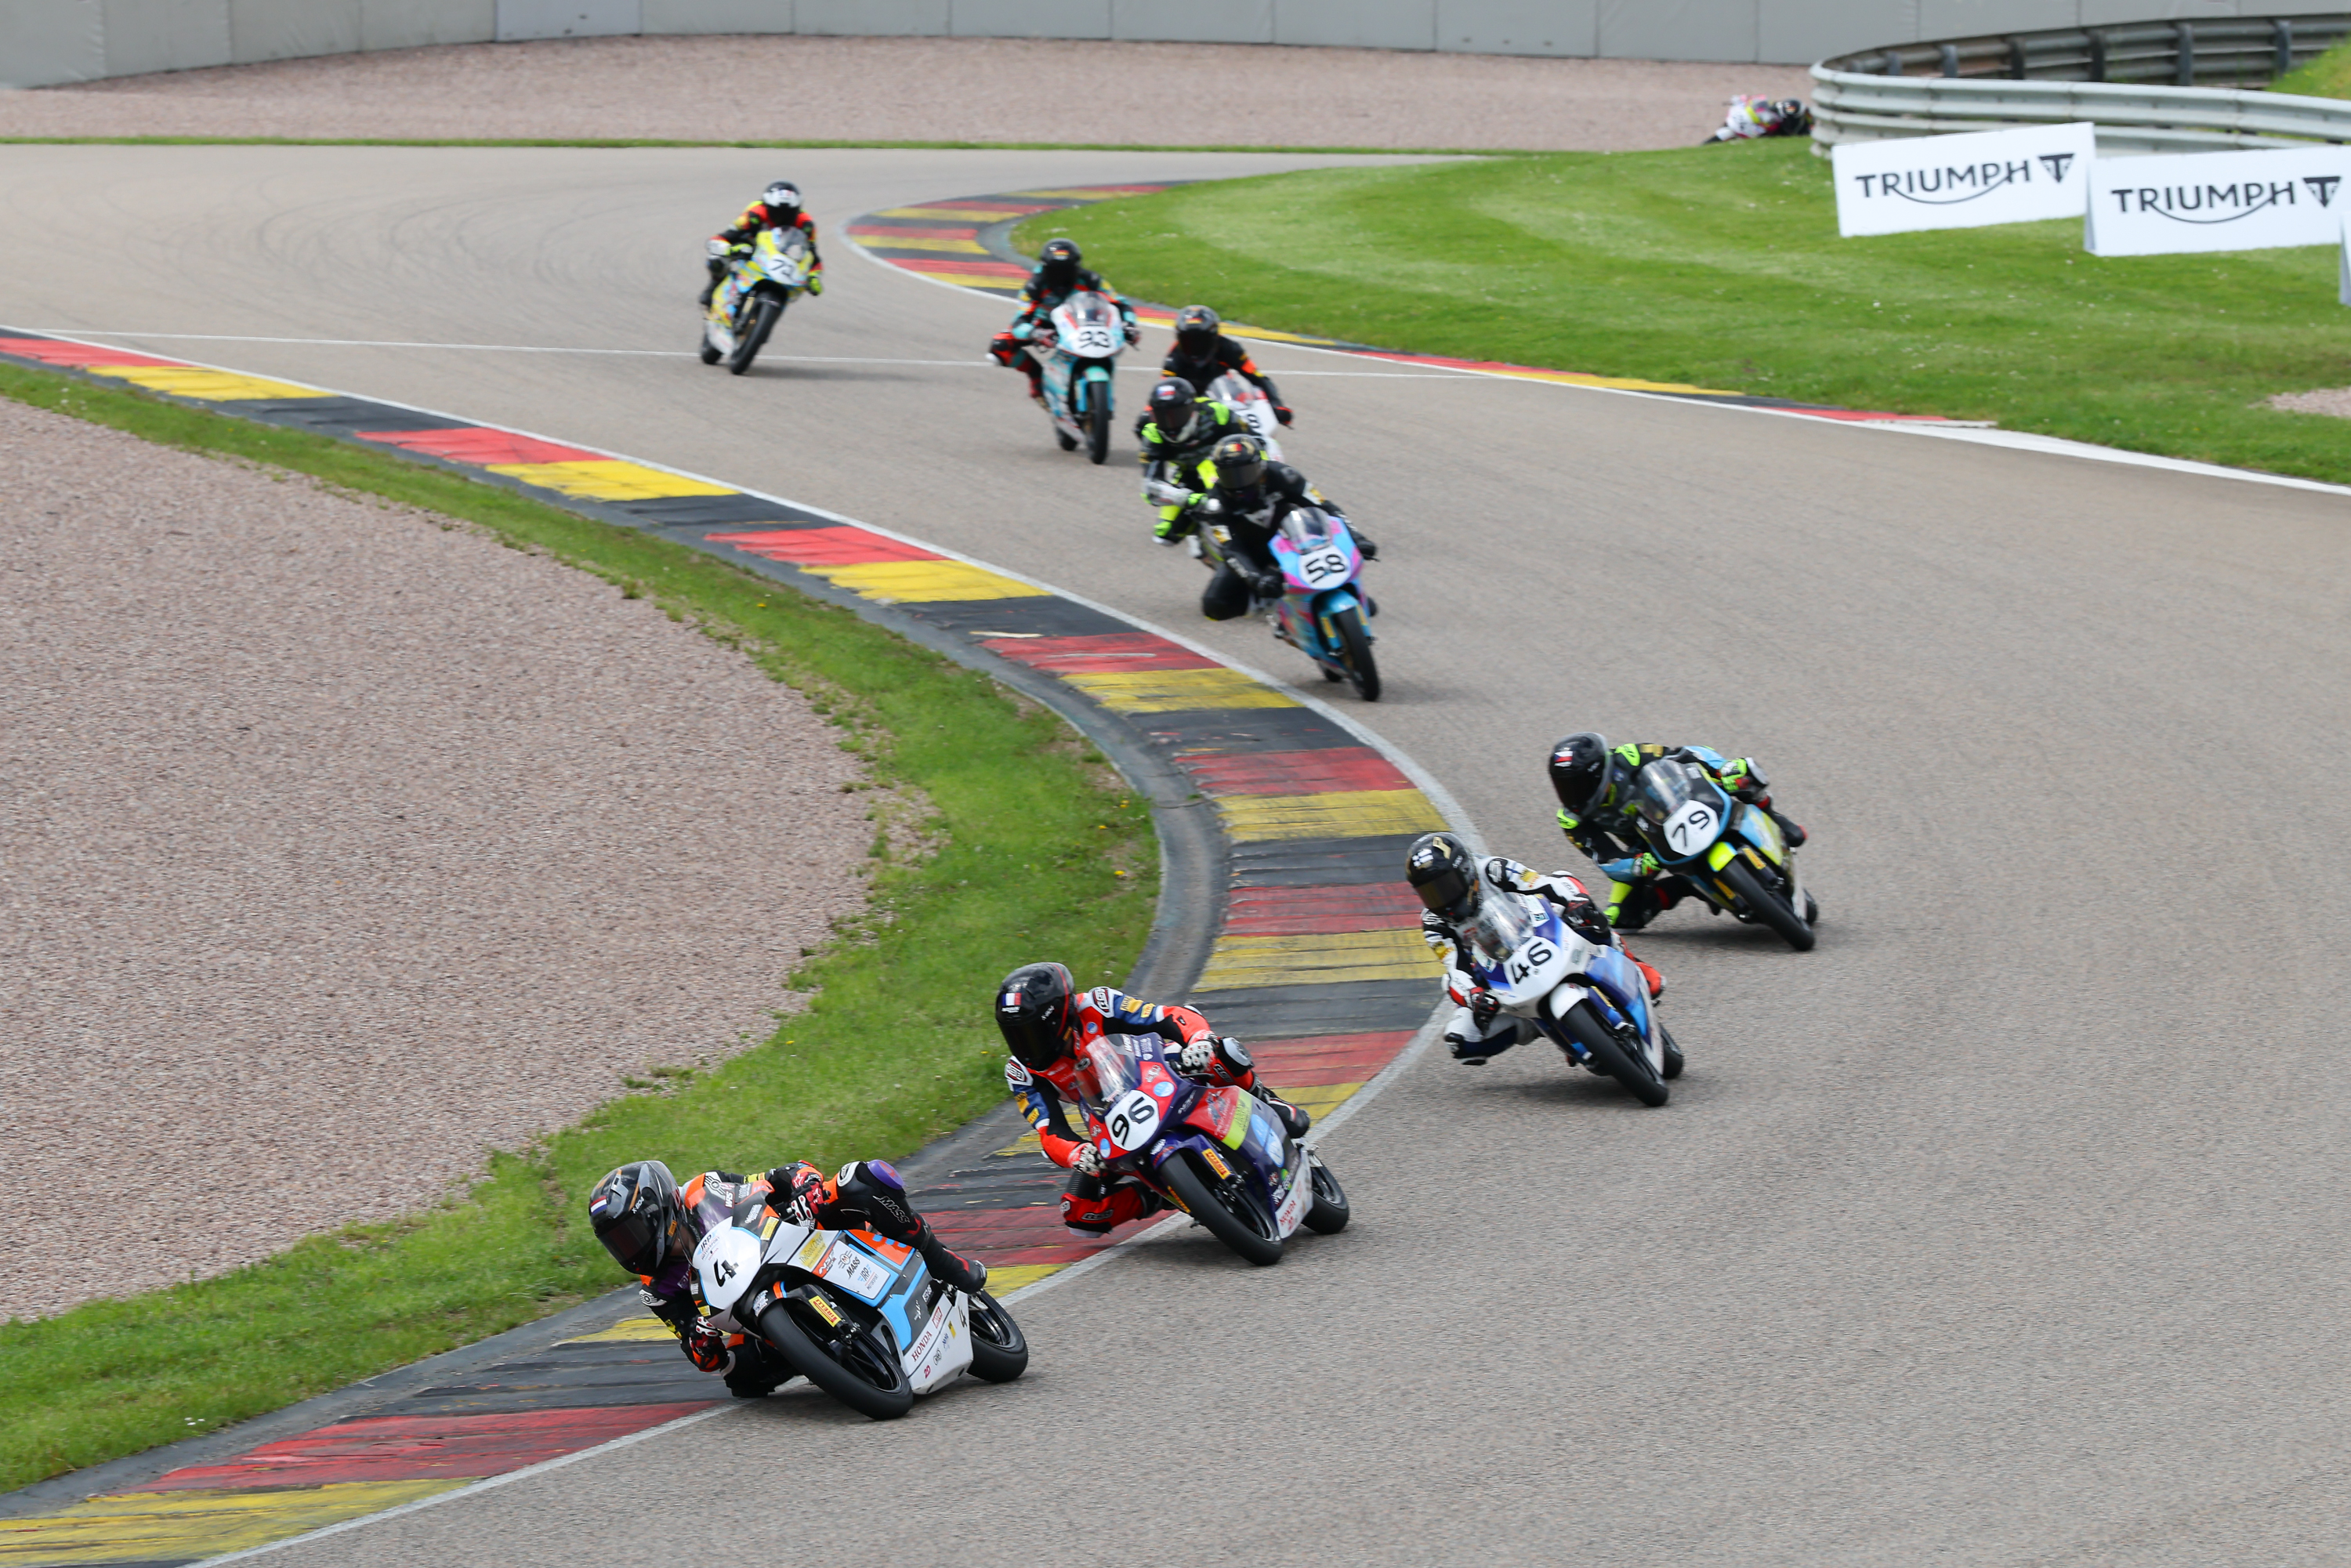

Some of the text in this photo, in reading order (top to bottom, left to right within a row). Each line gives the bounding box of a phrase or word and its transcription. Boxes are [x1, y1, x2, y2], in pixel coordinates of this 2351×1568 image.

[1855, 159, 2030, 205] TRIUMPH
[2110, 181, 2295, 223] TRIUMPH
[1305, 553, 1346, 584] 58
[1672, 809, 1710, 849] 79
[1510, 941, 1552, 985] 46
[1112, 1096, 1154, 1146] 96
[873, 1195, 910, 1223] MASS
[714, 1258, 739, 1287] 4
[846, 1256, 860, 1280] MASS
[866, 1273, 878, 1291] MOTORSPORT
[813, 1298, 838, 1324] PIRELLI
[911, 1331, 933, 1362] HONDA
